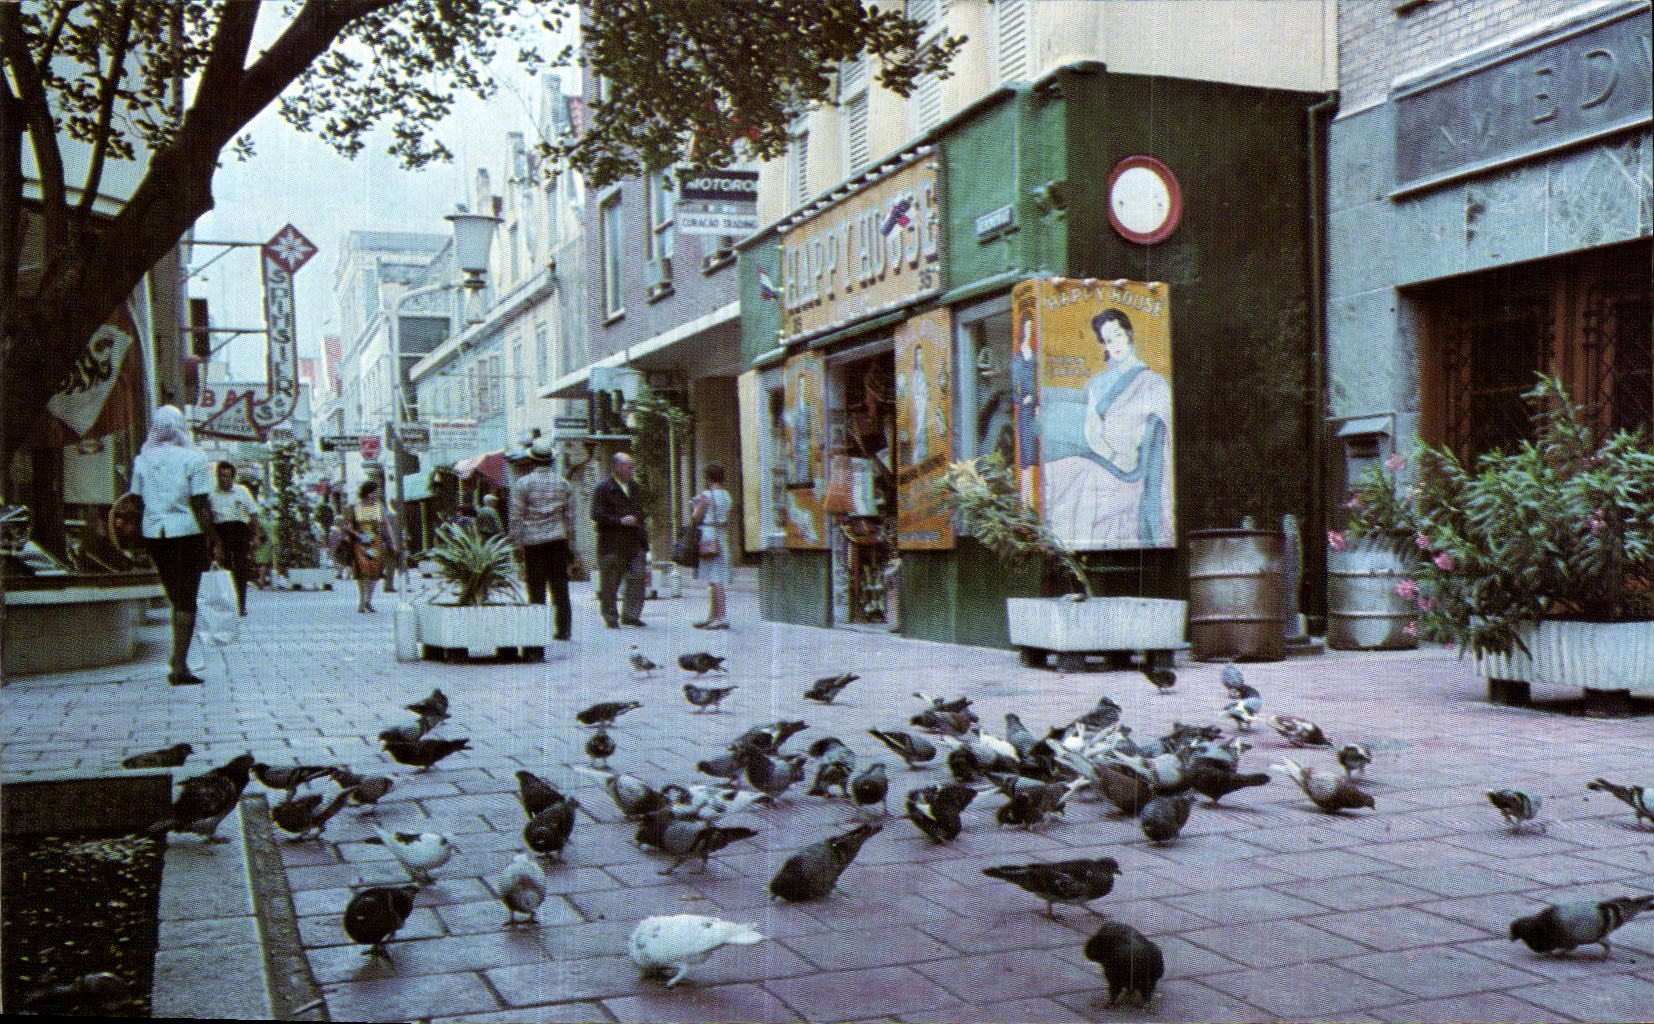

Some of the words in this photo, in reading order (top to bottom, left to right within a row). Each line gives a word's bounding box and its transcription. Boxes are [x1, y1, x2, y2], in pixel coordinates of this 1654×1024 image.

[785, 217, 854, 314] HAPPY
[855, 178, 939, 288] HOUSE
[1044, 286, 1106, 312] HAPPY
[1109, 287, 1165, 318] HOUSE
